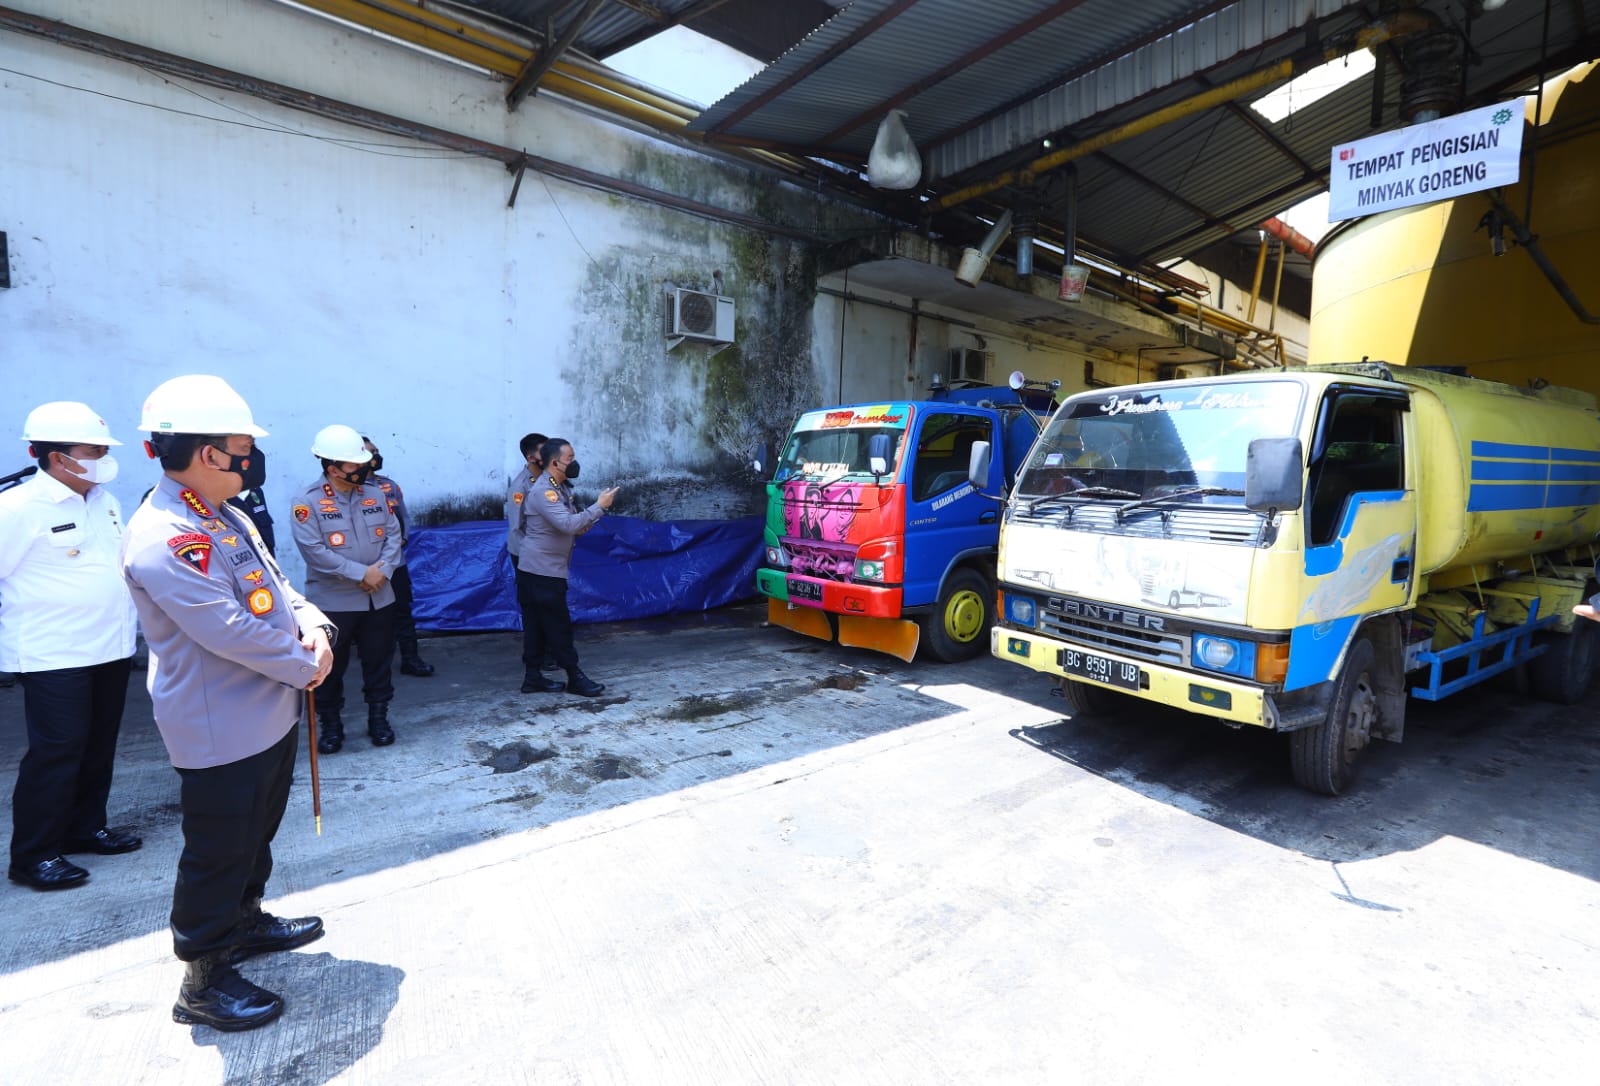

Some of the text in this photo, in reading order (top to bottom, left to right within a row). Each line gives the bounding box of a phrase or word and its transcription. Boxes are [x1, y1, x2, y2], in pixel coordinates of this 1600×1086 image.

[1348, 128, 1500, 180] TEMPAT PENGISIAN
[1357, 161, 1487, 207] MINYAK GORENG
[321, 512, 343, 520] TONI
[362, 506, 383, 516] POLRI
[1048, 597, 1165, 632] CANTER
[1066, 651, 1137, 682] BG 8591 UB
